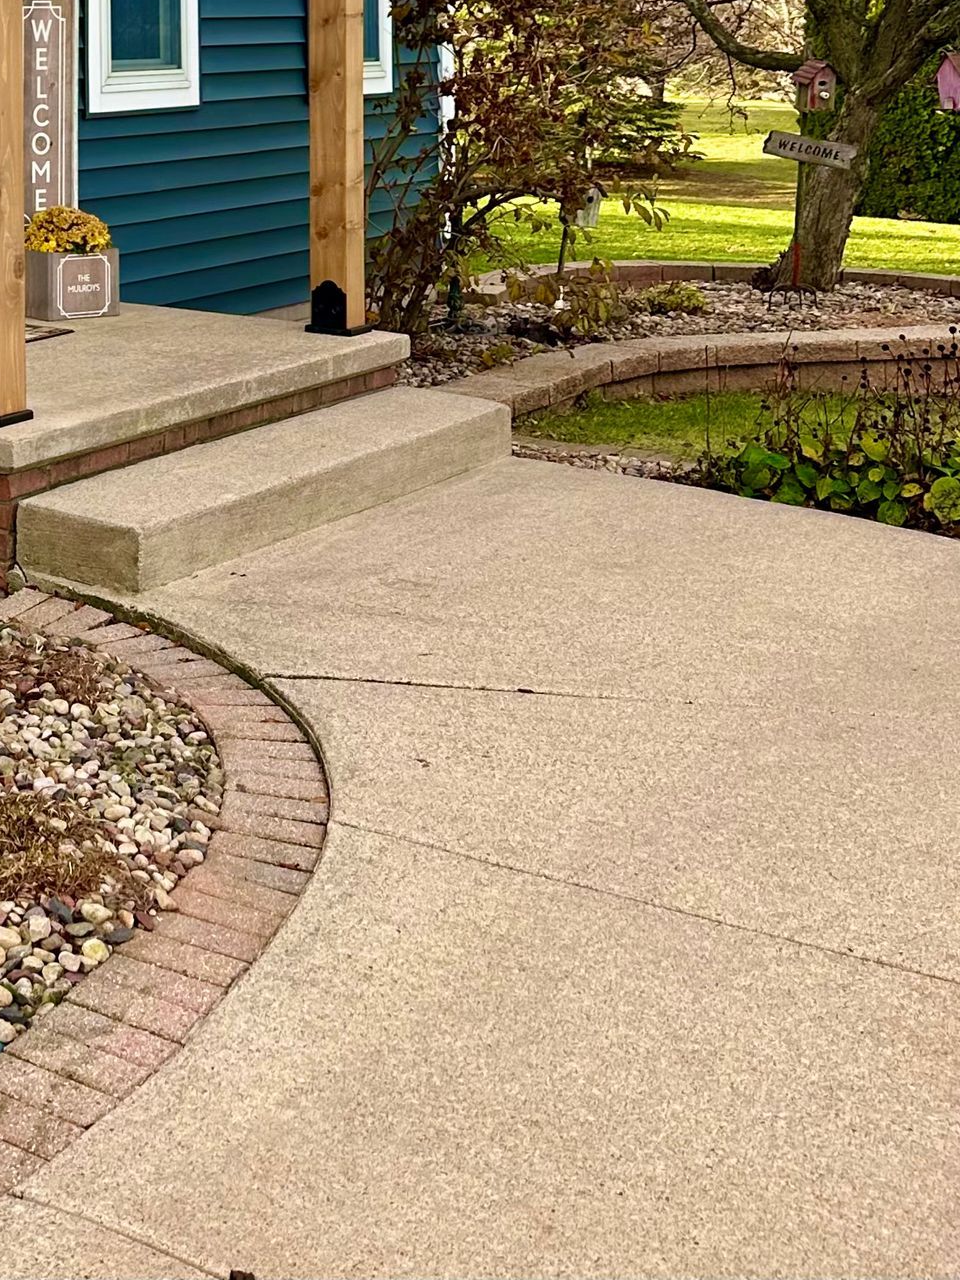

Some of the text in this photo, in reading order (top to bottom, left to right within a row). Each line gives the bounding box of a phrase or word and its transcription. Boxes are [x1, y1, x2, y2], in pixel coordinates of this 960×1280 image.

[30, 19, 53, 212] WELCOME
[778, 139, 841, 160] WELCOME
[77, 273, 91, 282] THE
